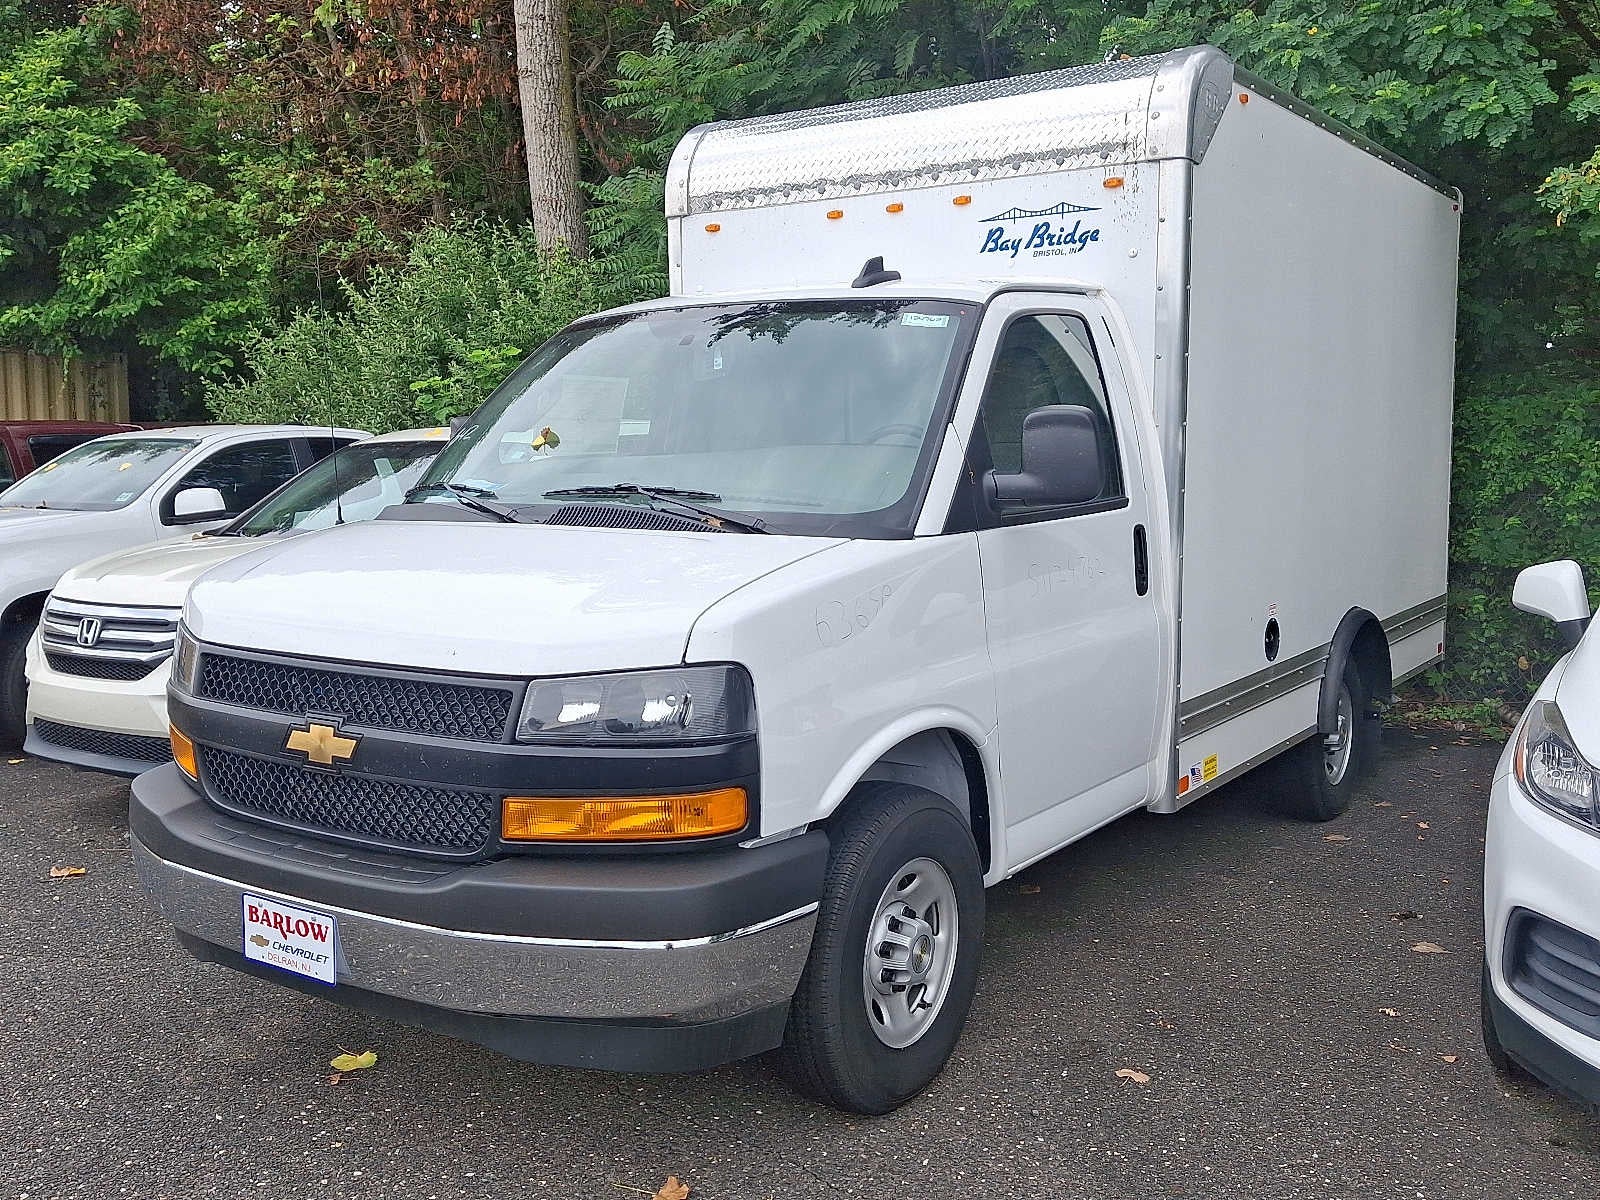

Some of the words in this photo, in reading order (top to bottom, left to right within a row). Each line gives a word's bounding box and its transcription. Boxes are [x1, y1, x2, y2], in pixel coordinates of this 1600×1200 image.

[980, 226, 1023, 258] Bay
[1024, 219, 1100, 253] Bridge
[1032, 248, 1067, 258] BRISTOL,
[247, 904, 330, 943] BARLOW
[267, 951, 300, 970] DELRAN,
[272, 941, 329, 964] CHEVROLET
